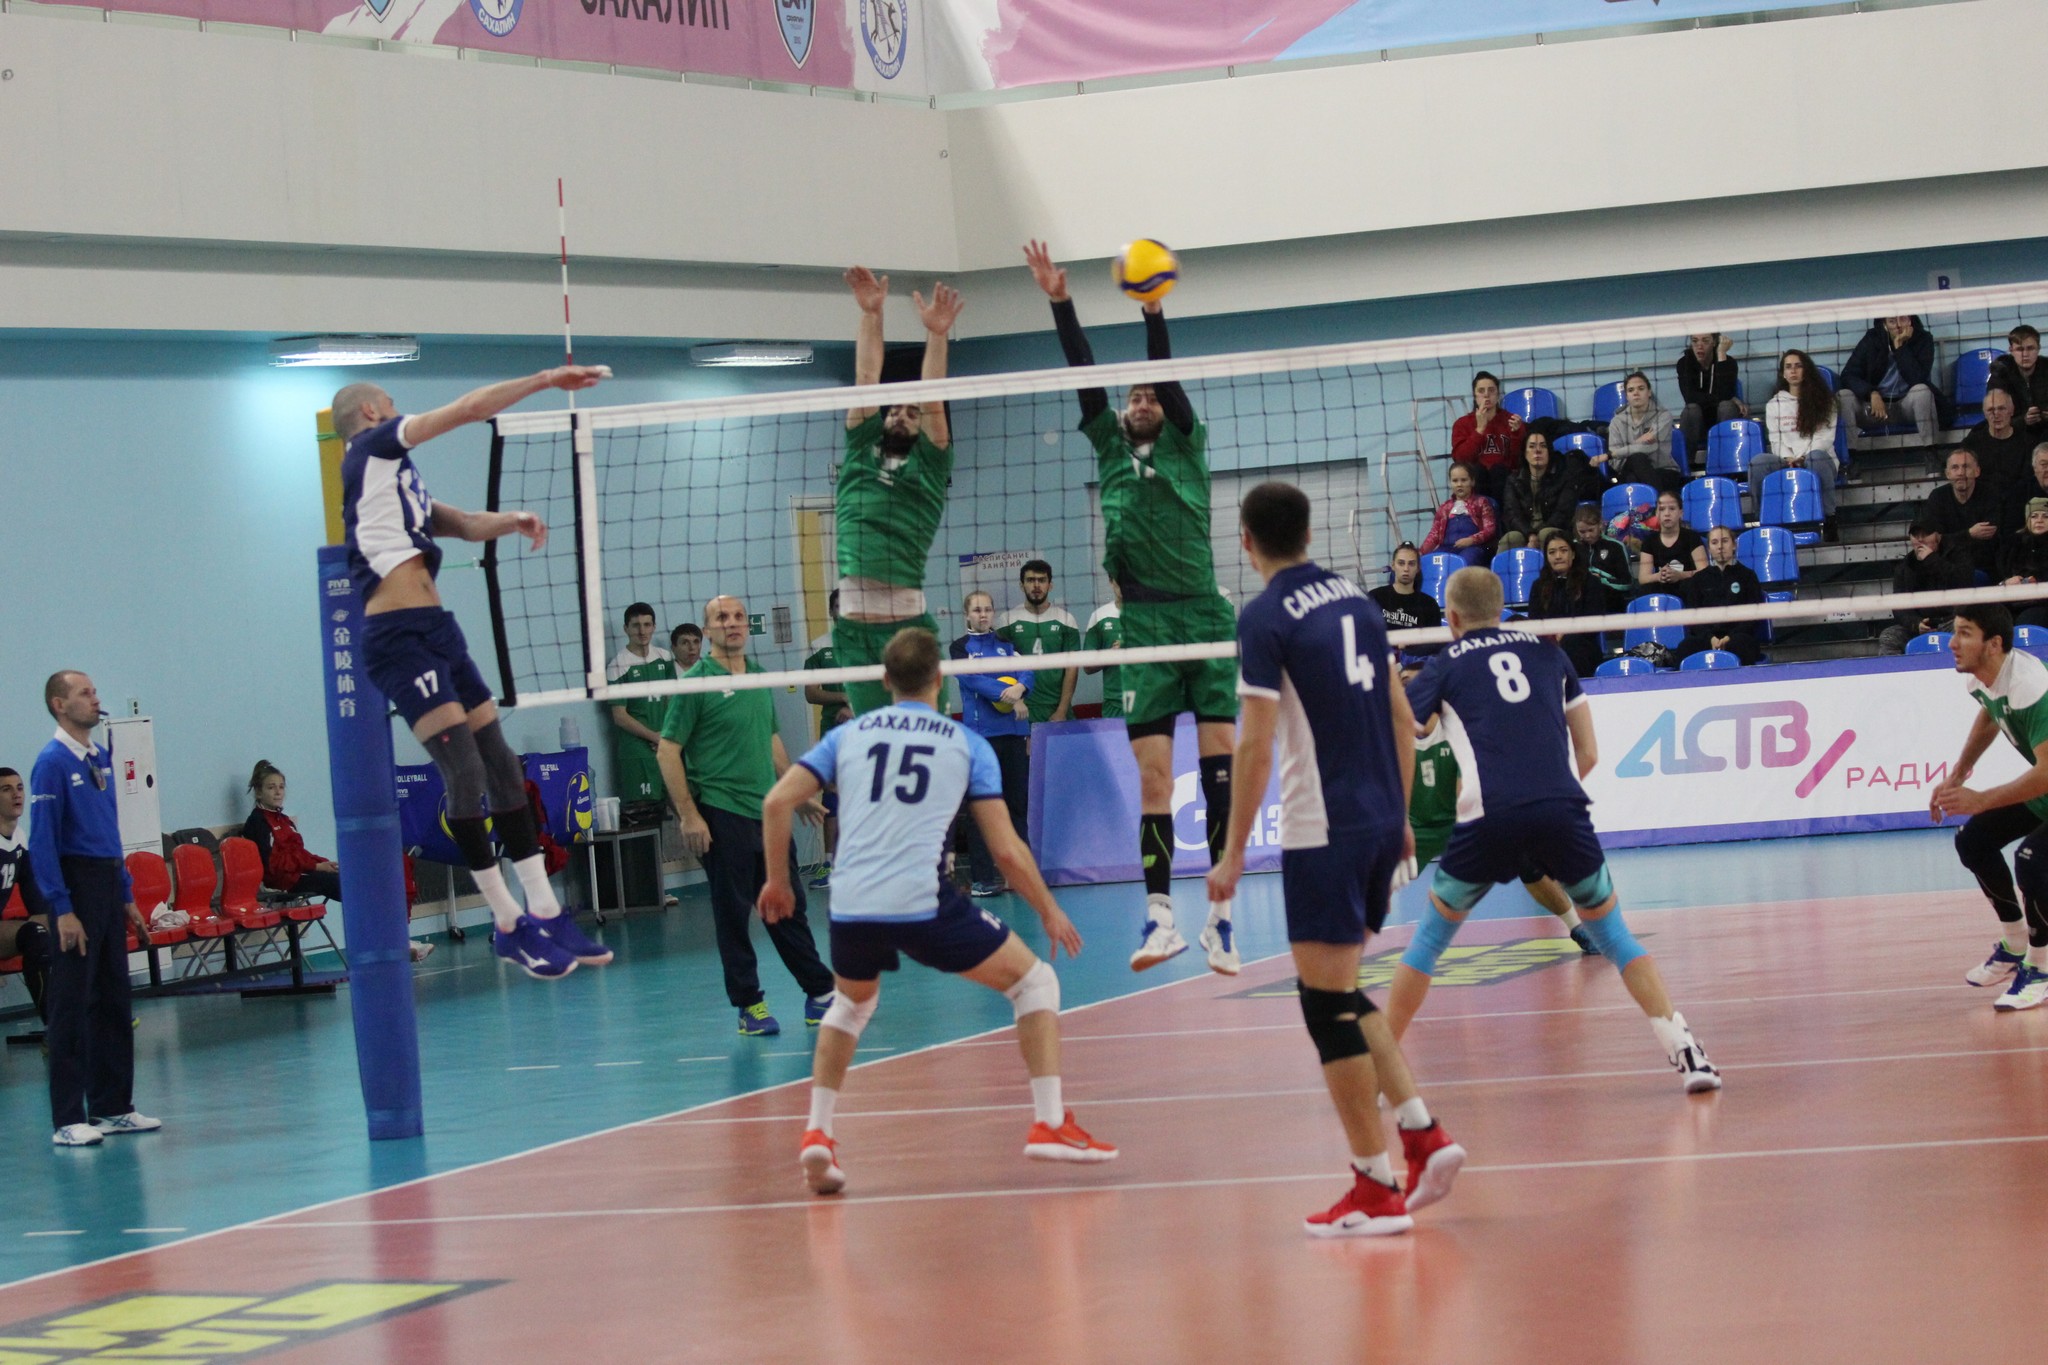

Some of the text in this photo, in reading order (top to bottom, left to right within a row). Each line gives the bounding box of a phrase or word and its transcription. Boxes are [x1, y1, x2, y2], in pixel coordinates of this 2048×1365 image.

[973, 552, 1029, 564] РАСПИСАНИЕ
[983, 560, 1021, 570] ЗАНЯТИЙ
[1032, 637, 1043, 655] 4
[1341, 614, 1375, 692] 4
[1448, 631, 1540, 659] САХАЛИН
[333, 626, 356, 718] 金陵体育
[414, 669, 439, 698] 17
[1487, 651, 1531, 704] 8
[859, 713, 955, 738] САХАЛИН
[396, 774, 427, 783] OLLEYBALL
[866, 742, 935, 805] 15
[1420, 759, 1435, 787] 5
[640, 782, 651, 795] 14
[1, 863, 15, 889] 12
